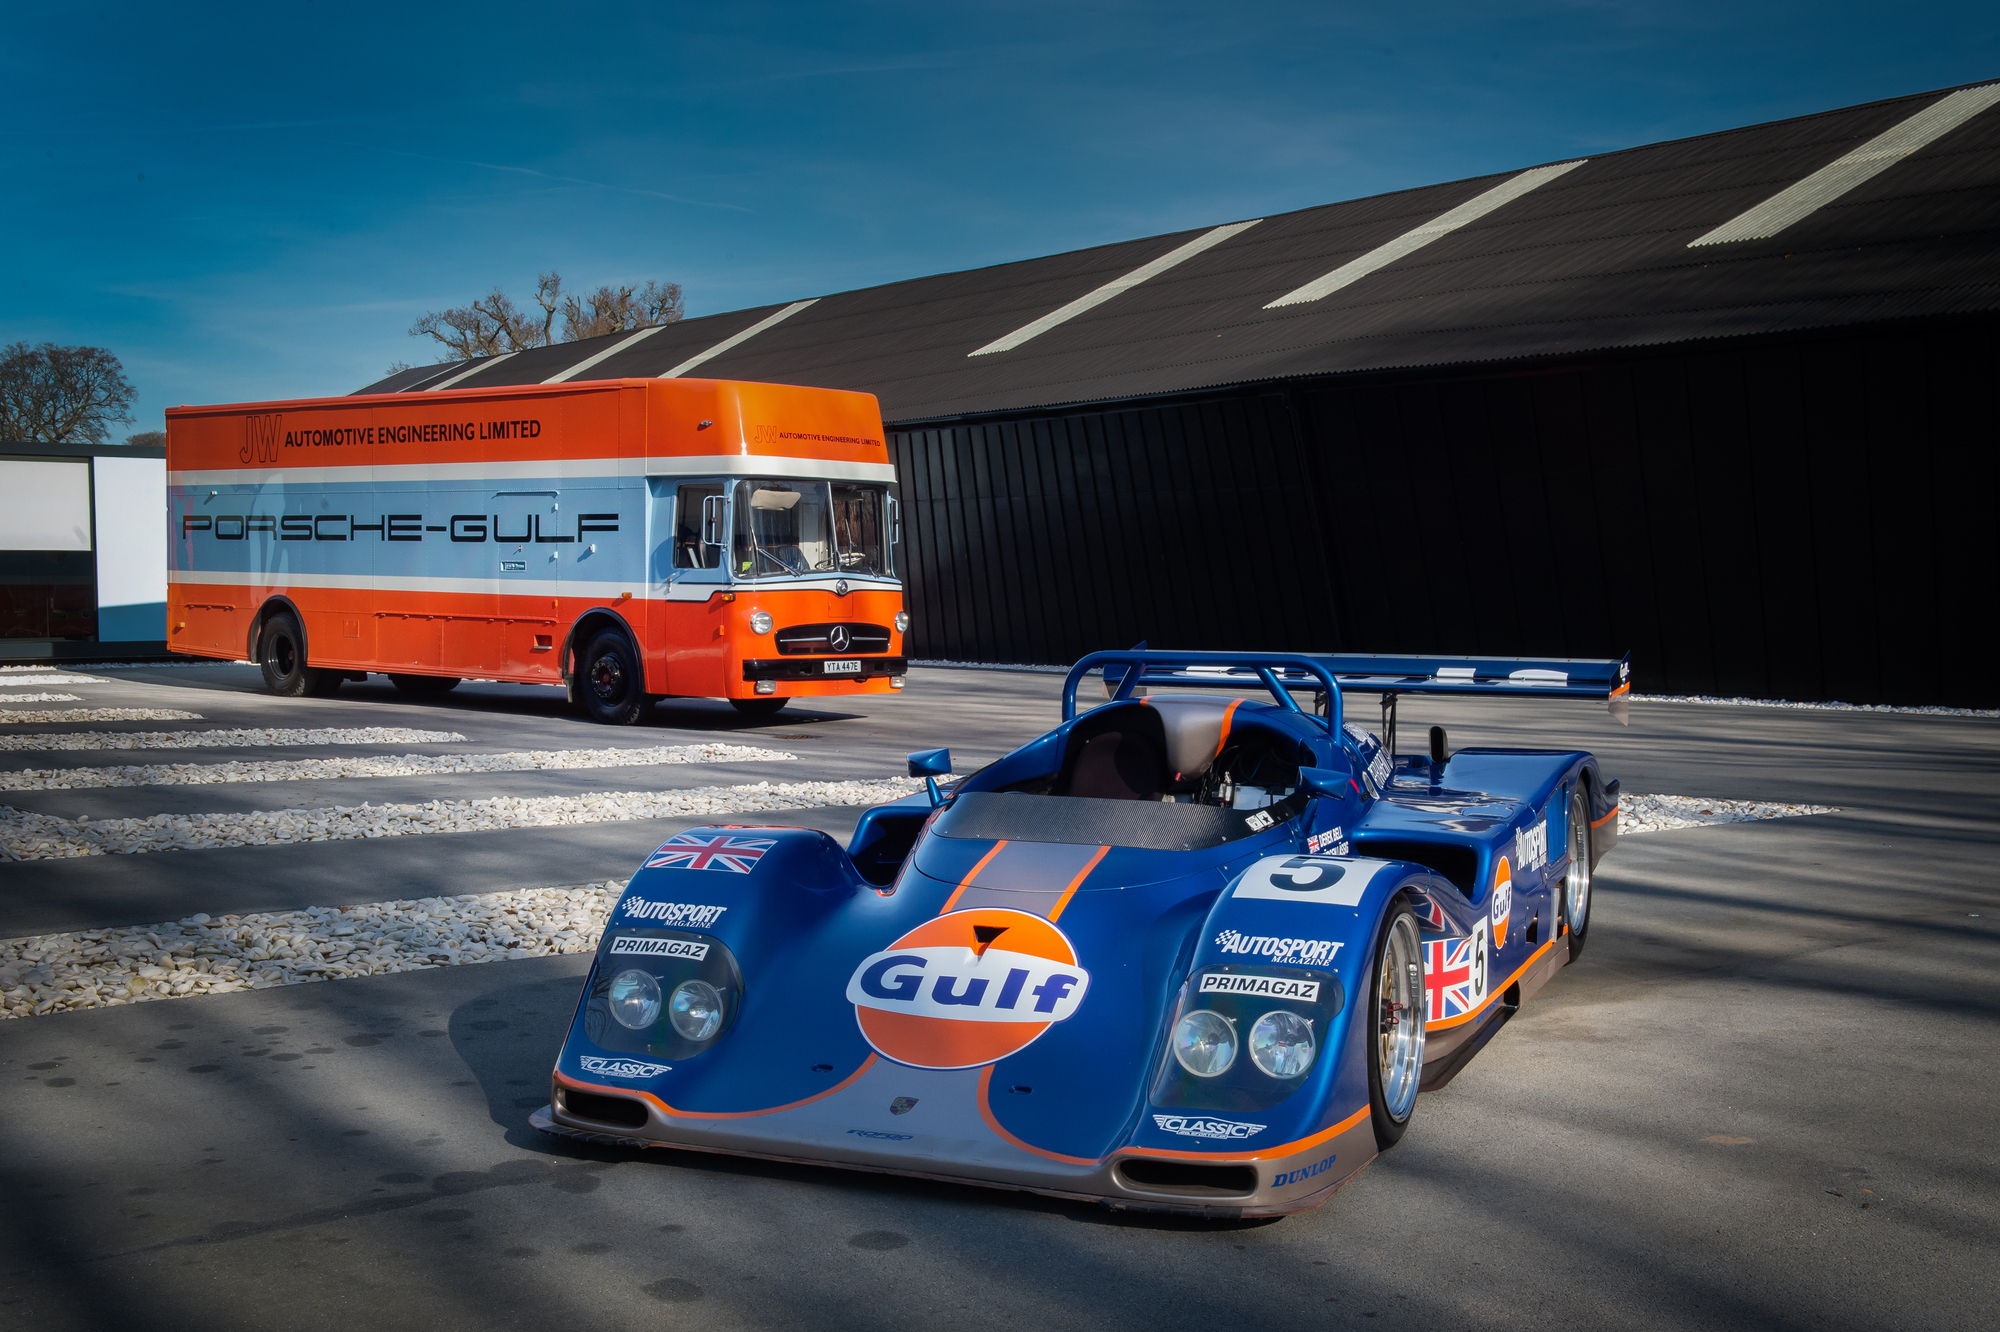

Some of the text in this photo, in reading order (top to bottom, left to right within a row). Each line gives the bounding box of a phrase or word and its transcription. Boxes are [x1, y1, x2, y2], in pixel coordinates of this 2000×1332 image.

[239, 414, 541, 464] JW AUTOMOTIVE ENGINEERING LIMITED
[779, 432, 821, 442] AUTOMOTIVE
[822, 435, 860, 445] ENGINEERING
[861, 438, 881, 447] LIMITED
[182, 513, 619, 543] PORSCHE-GULF
[827, 662, 858, 671] YTA 447E
[1319, 825, 1343, 847] DEREK BELL
[1269, 855, 1355, 892] 5
[625, 899, 728, 924] AUTOSPORT
[1493, 886, 1511, 920] Gulf
[663, 919, 713, 929] MAGAZINE
[614, 939, 705, 958] PRIMAGAZ
[1221, 933, 1345, 962] AUTOSPORT
[1271, 955, 1331, 967] MAGAZINE
[1474, 928, 1485, 997] 5
[859, 954, 1080, 1014] Gulf
[1203, 977, 1315, 998] PRIMAGAZ
[586, 1060, 655, 1076] CLASSIC
[1165, 1118, 1248, 1137] CLASSIC
[1271, 1154, 1337, 1188] DUNLOP
